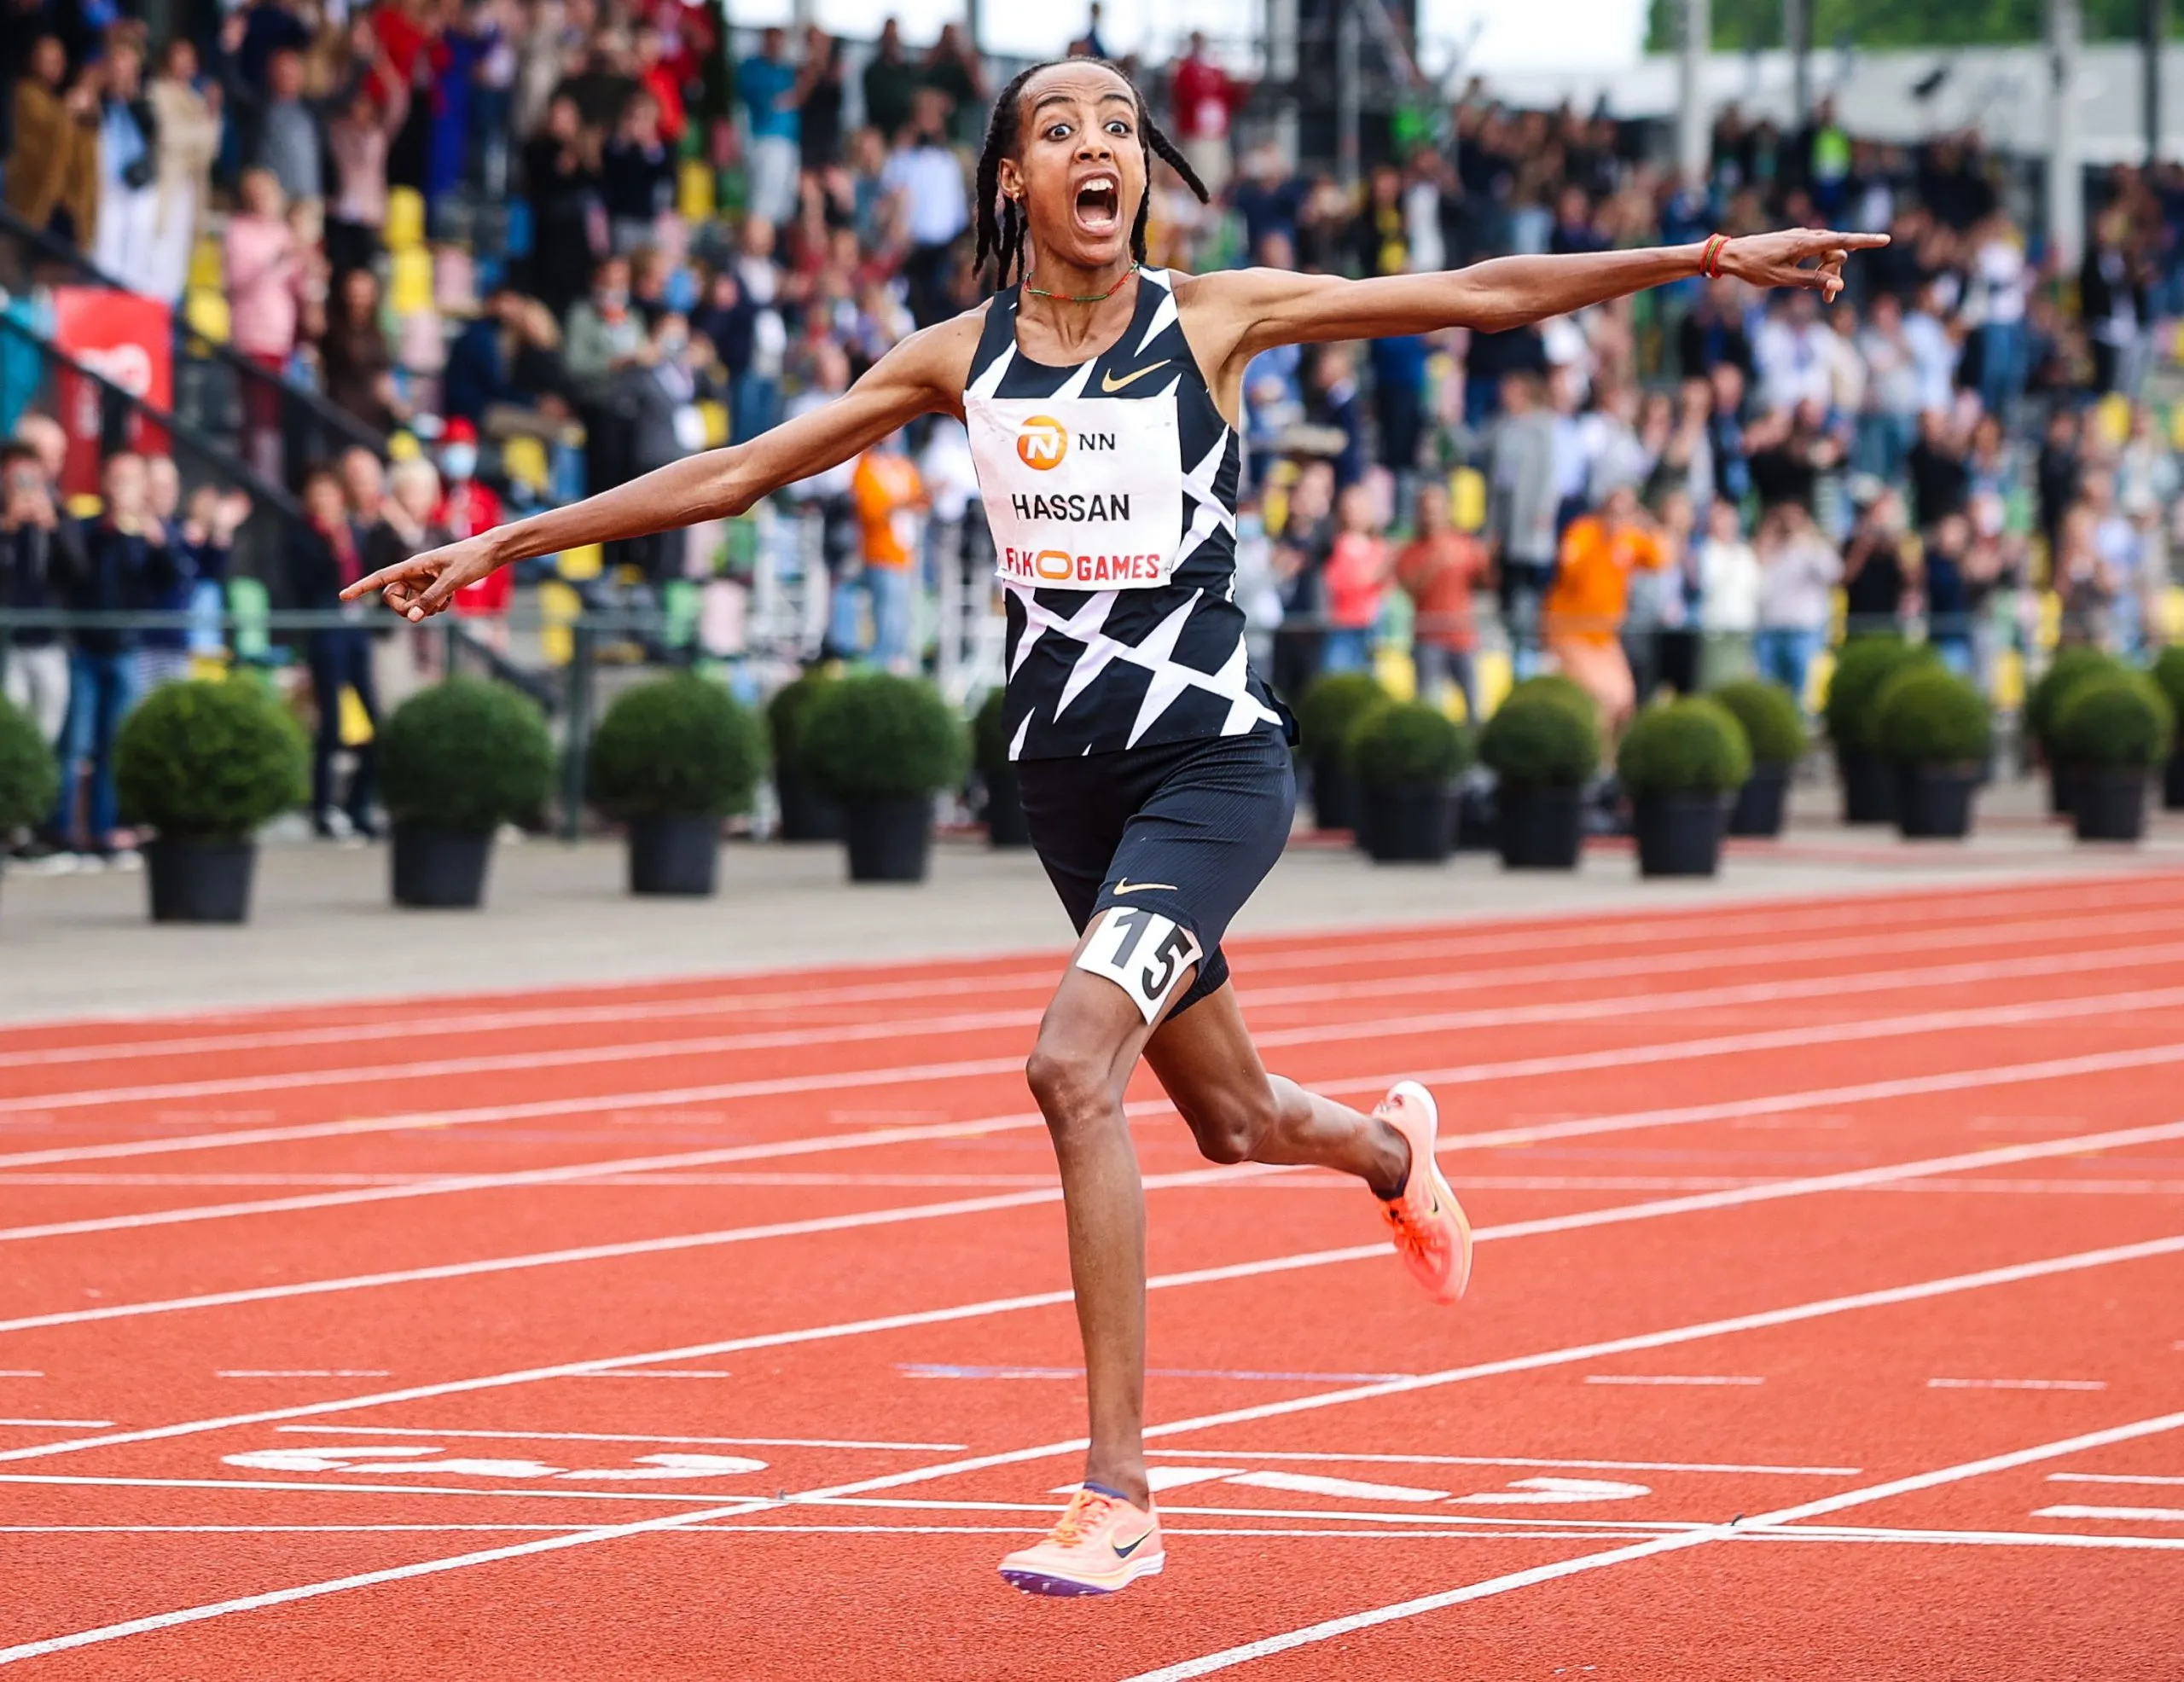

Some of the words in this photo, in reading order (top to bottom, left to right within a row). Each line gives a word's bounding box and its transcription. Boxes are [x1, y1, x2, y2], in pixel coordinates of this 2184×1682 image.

[1079, 433, 1116, 450] NN
[1012, 493, 1130, 522] HASSAN
[1077, 554, 1160, 581] GAMES
[1111, 910, 1193, 1000] 15
